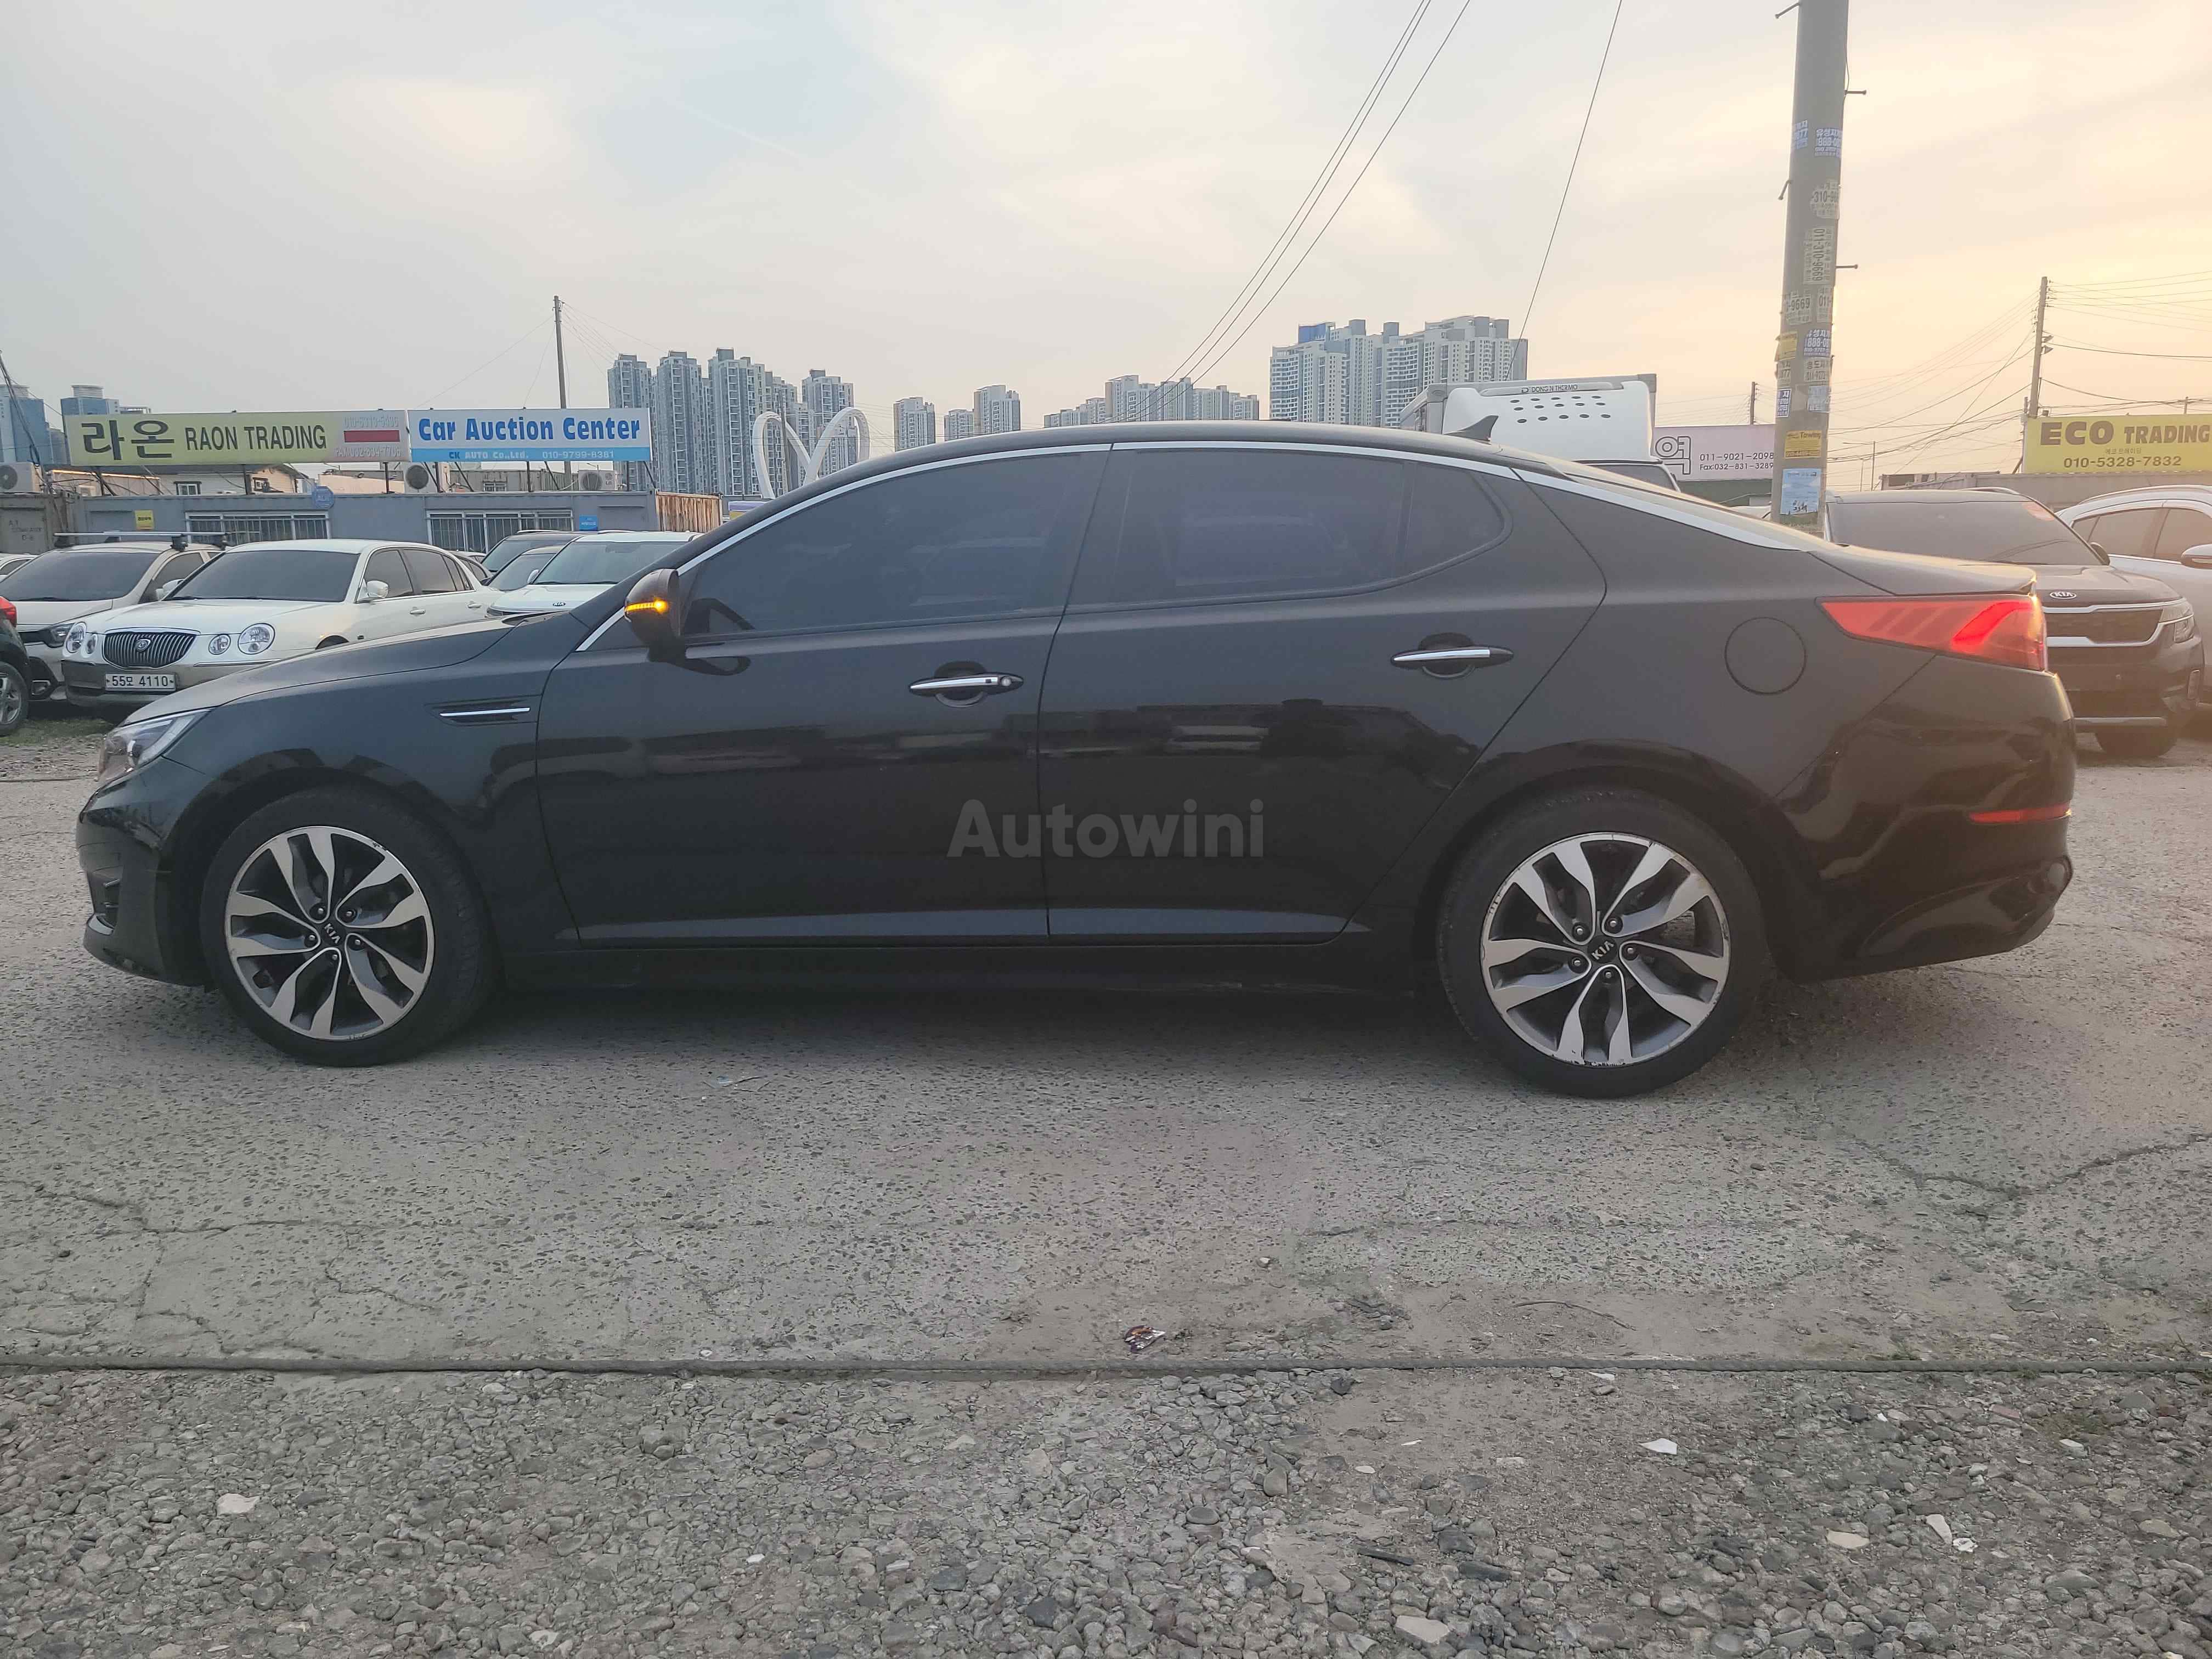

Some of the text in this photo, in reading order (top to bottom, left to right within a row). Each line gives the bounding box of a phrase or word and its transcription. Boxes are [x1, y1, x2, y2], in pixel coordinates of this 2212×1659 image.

[185, 425, 327, 450] RAON TRADING
[419, 417, 640, 441] Car Auction Center
[2040, 421, 2211, 445] ECO TRADING
[81, 420, 174, 460] 라온
[449, 451, 460, 459] CK
[465, 451, 488, 459] AUTO
[1700, 452, 1774, 461] 011-9021-2098
[2063, 456, 2182, 468] 010-5328-7832
[139, 675, 168, 687] 4110
[324, 923, 340, 944] KIA
[1592, 940, 1615, 960] KIA
